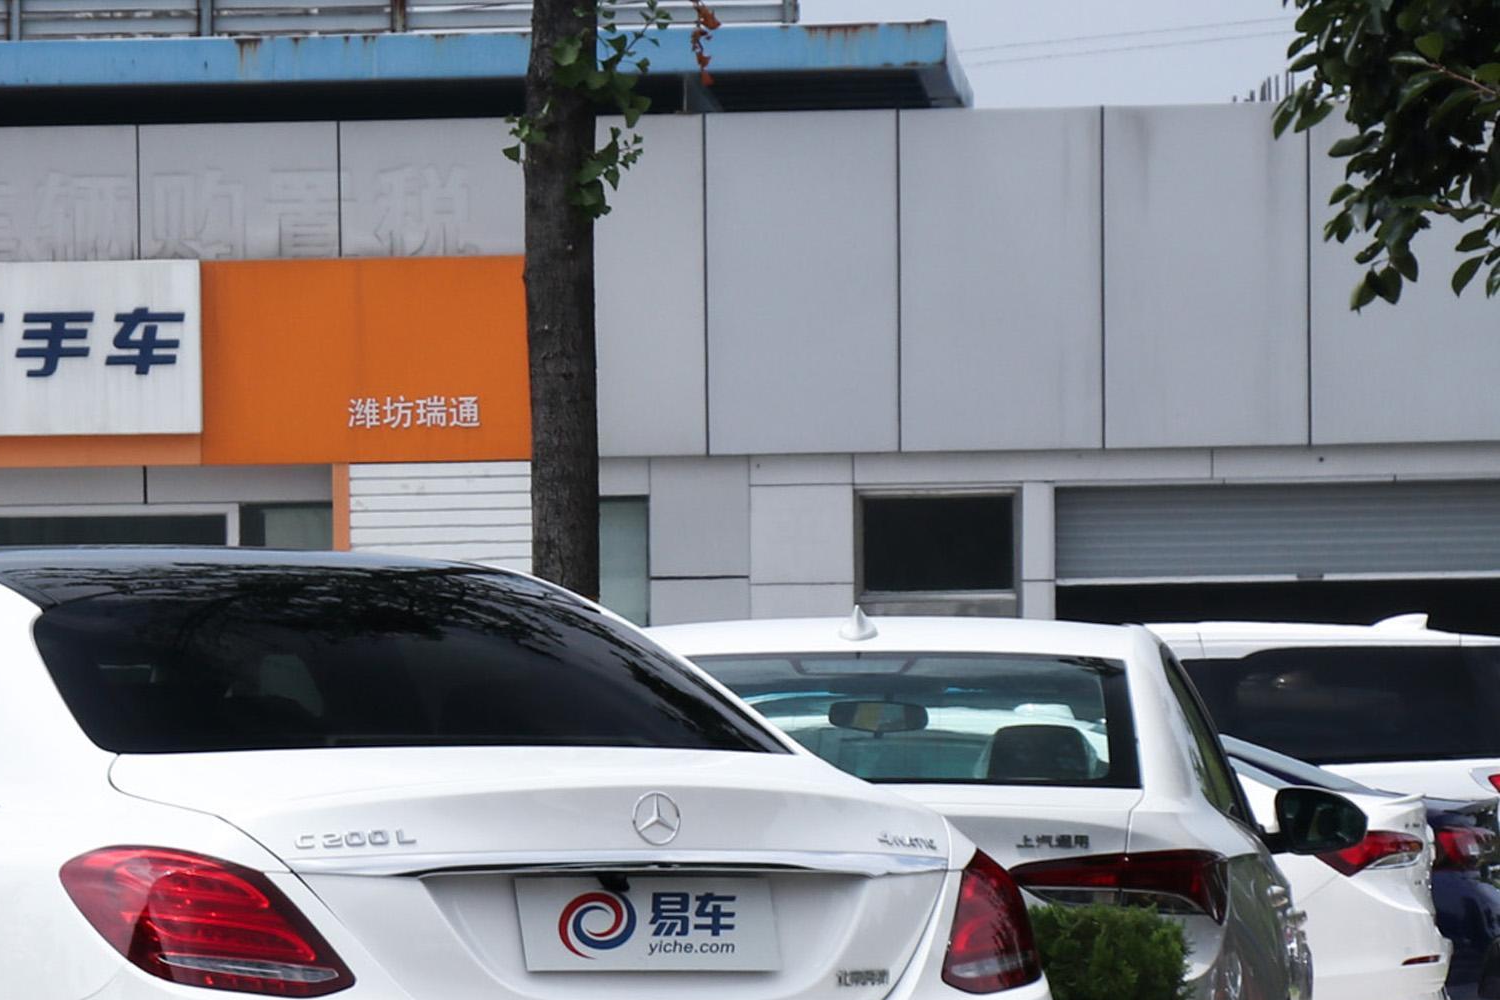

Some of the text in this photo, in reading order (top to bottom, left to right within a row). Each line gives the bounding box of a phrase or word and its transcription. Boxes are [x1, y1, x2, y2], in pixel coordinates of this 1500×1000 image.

[347, 395, 481, 430] 潍坊瑞通
[648, 891, 737, 937] 易车
[648, 939, 736, 956] yiche.com
